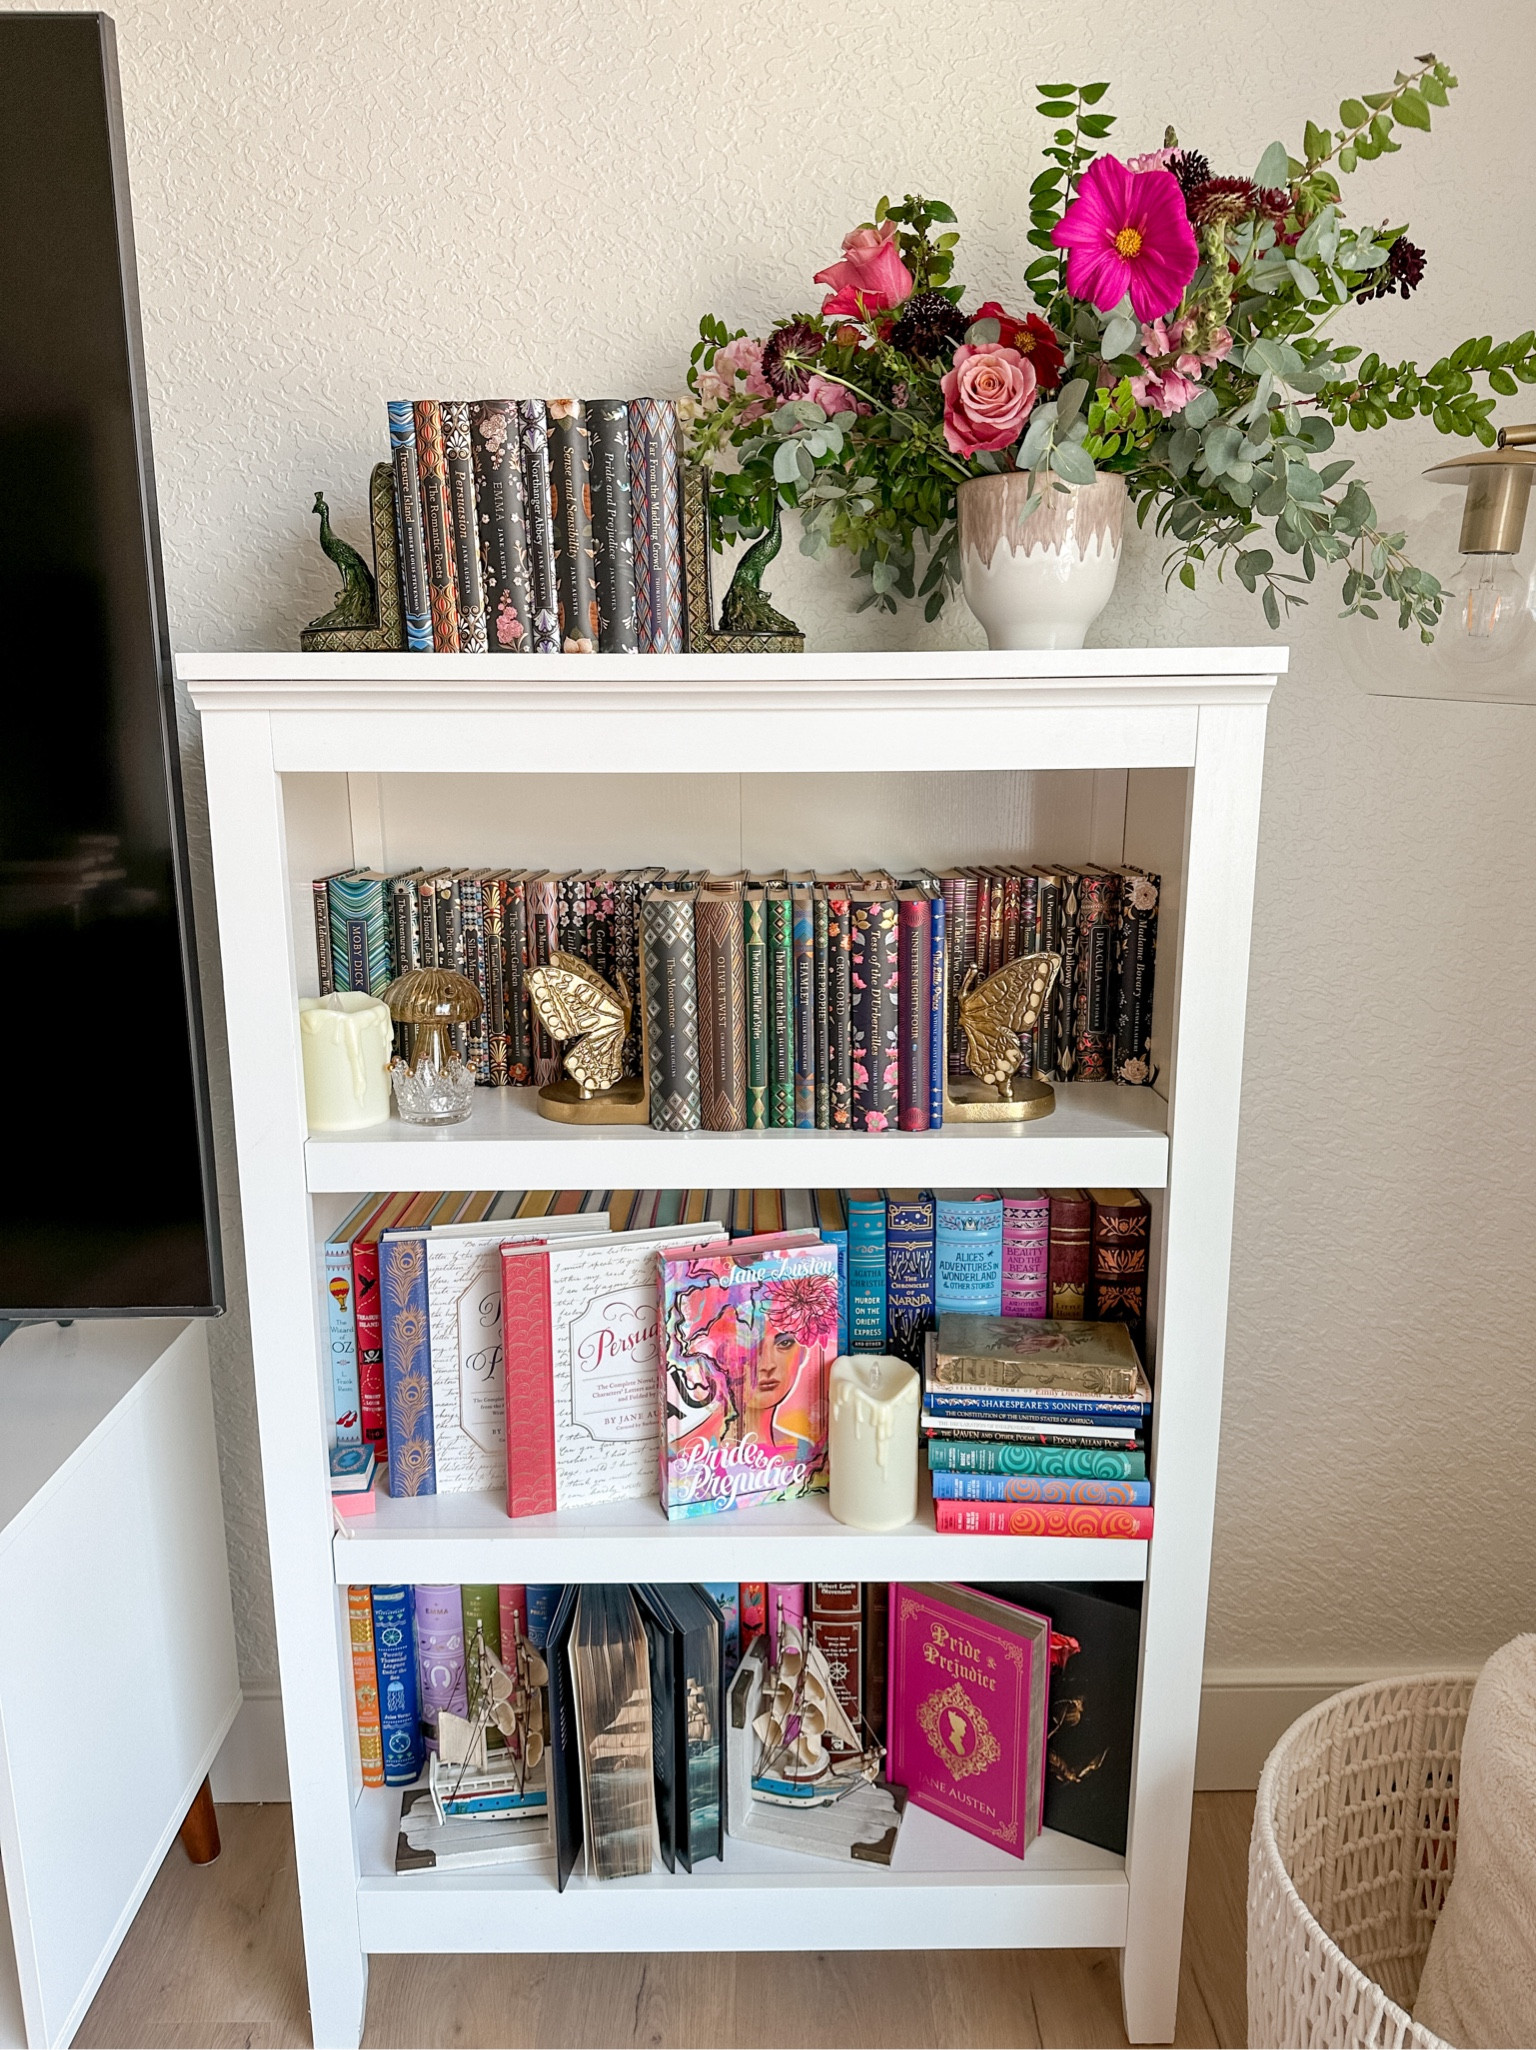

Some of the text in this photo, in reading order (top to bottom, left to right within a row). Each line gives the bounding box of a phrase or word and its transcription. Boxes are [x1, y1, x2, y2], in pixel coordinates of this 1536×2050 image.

[564, 446, 575, 476] Sense
[398, 450, 414, 523] Treasure Island
[455, 470, 469, 539] Persuasion
[493, 482, 504, 521] EMMA
[566, 480, 577, 501] and
[649, 441, 662, 571] Far From the Madding Crowd
[605, 453, 618, 560] Pride and Prejudice
[428, 483, 443, 579] The Romantic Poets
[531, 460, 547, 601] Northanger Abbey JANE AUSTEN
[566, 504, 579, 560] Sensibility
[461, 545, 469, 563] JANE
[316, 898, 326, 921] Alice's
[398, 899, 406, 912] The
[318, 923, 328, 968] Adventures
[399, 914, 409, 953] Adventures
[423, 899, 434, 964] The Hound of the
[446, 910, 457, 966] The Picture of
[468, 938, 476, 956] Silas
[509, 912, 519, 987] The Secret Garden
[538, 935, 546, 956] Mayor
[597, 929, 605, 954] Good
[954, 926, 962, 943] Tale
[954, 946, 962, 955] of
[978, 924, 986, 969] Christmas
[353, 926, 363, 986] MOBY DICK
[753, 950, 761, 960] The
[954, 956, 962, 971] Two
[1062, 927, 1074, 989] Mrs Dalloway
[1095, 933, 1103, 981] DRACULA
[1133, 920, 1147, 998] Madame Bovary
[667, 958, 676, 1028] The Moonstone
[717, 956, 727, 1028] OLIVER TWIST
[751, 962, 761, 994] Mysterious
[775, 951, 787, 1034] The Murder on the Links
[800, 962, 808, 1006] HAMLET
[818, 960, 826, 1024] THE PROPHET
[836, 956, 844, 1015] CRANFORD
[870, 931, 881, 1056] Tess of the D'Urbervilles
[932, 950, 942, 1011] The Little Prince
[753, 995, 762, 1011] Affair
[753, 1021, 762, 1040] Styles
[720, 1263, 765, 1286] Jane
[771, 1257, 834, 1276] Austen
[939, 1261, 992, 1272] ADVENTURES
[955, 1253, 984, 1262] ALICE'S
[1007, 1248, 1043, 1256] BEAUTY
[1010, 1264, 1040, 1272] BEAST
[942, 1271, 997, 1281] WONDERLAND
[950, 1282, 970, 1290] OTHER
[971, 1281, 994, 1289] STORIES
[889, 1294, 932, 1307] NARNIA
[332, 1342, 354, 1353] OZ
[620, 1415, 644, 1424] JANE
[981, 1400, 1093, 1411] SHAKESPEARE'S SONNETS
[674, 1432, 758, 1473] Pride
[953, 1430, 980, 1439] RAVEN
[994, 1432, 1015, 1440] OTHER
[1053, 1436, 1077, 1445] EDGAR
[1080, 1438, 1101, 1446] ALLAN
[679, 1455, 807, 1510] Prejudice
[930, 1622, 980, 1662] Pride
[923, 1643, 996, 1691] Prejudice
[949, 1788, 996, 1818] AUSTEN
